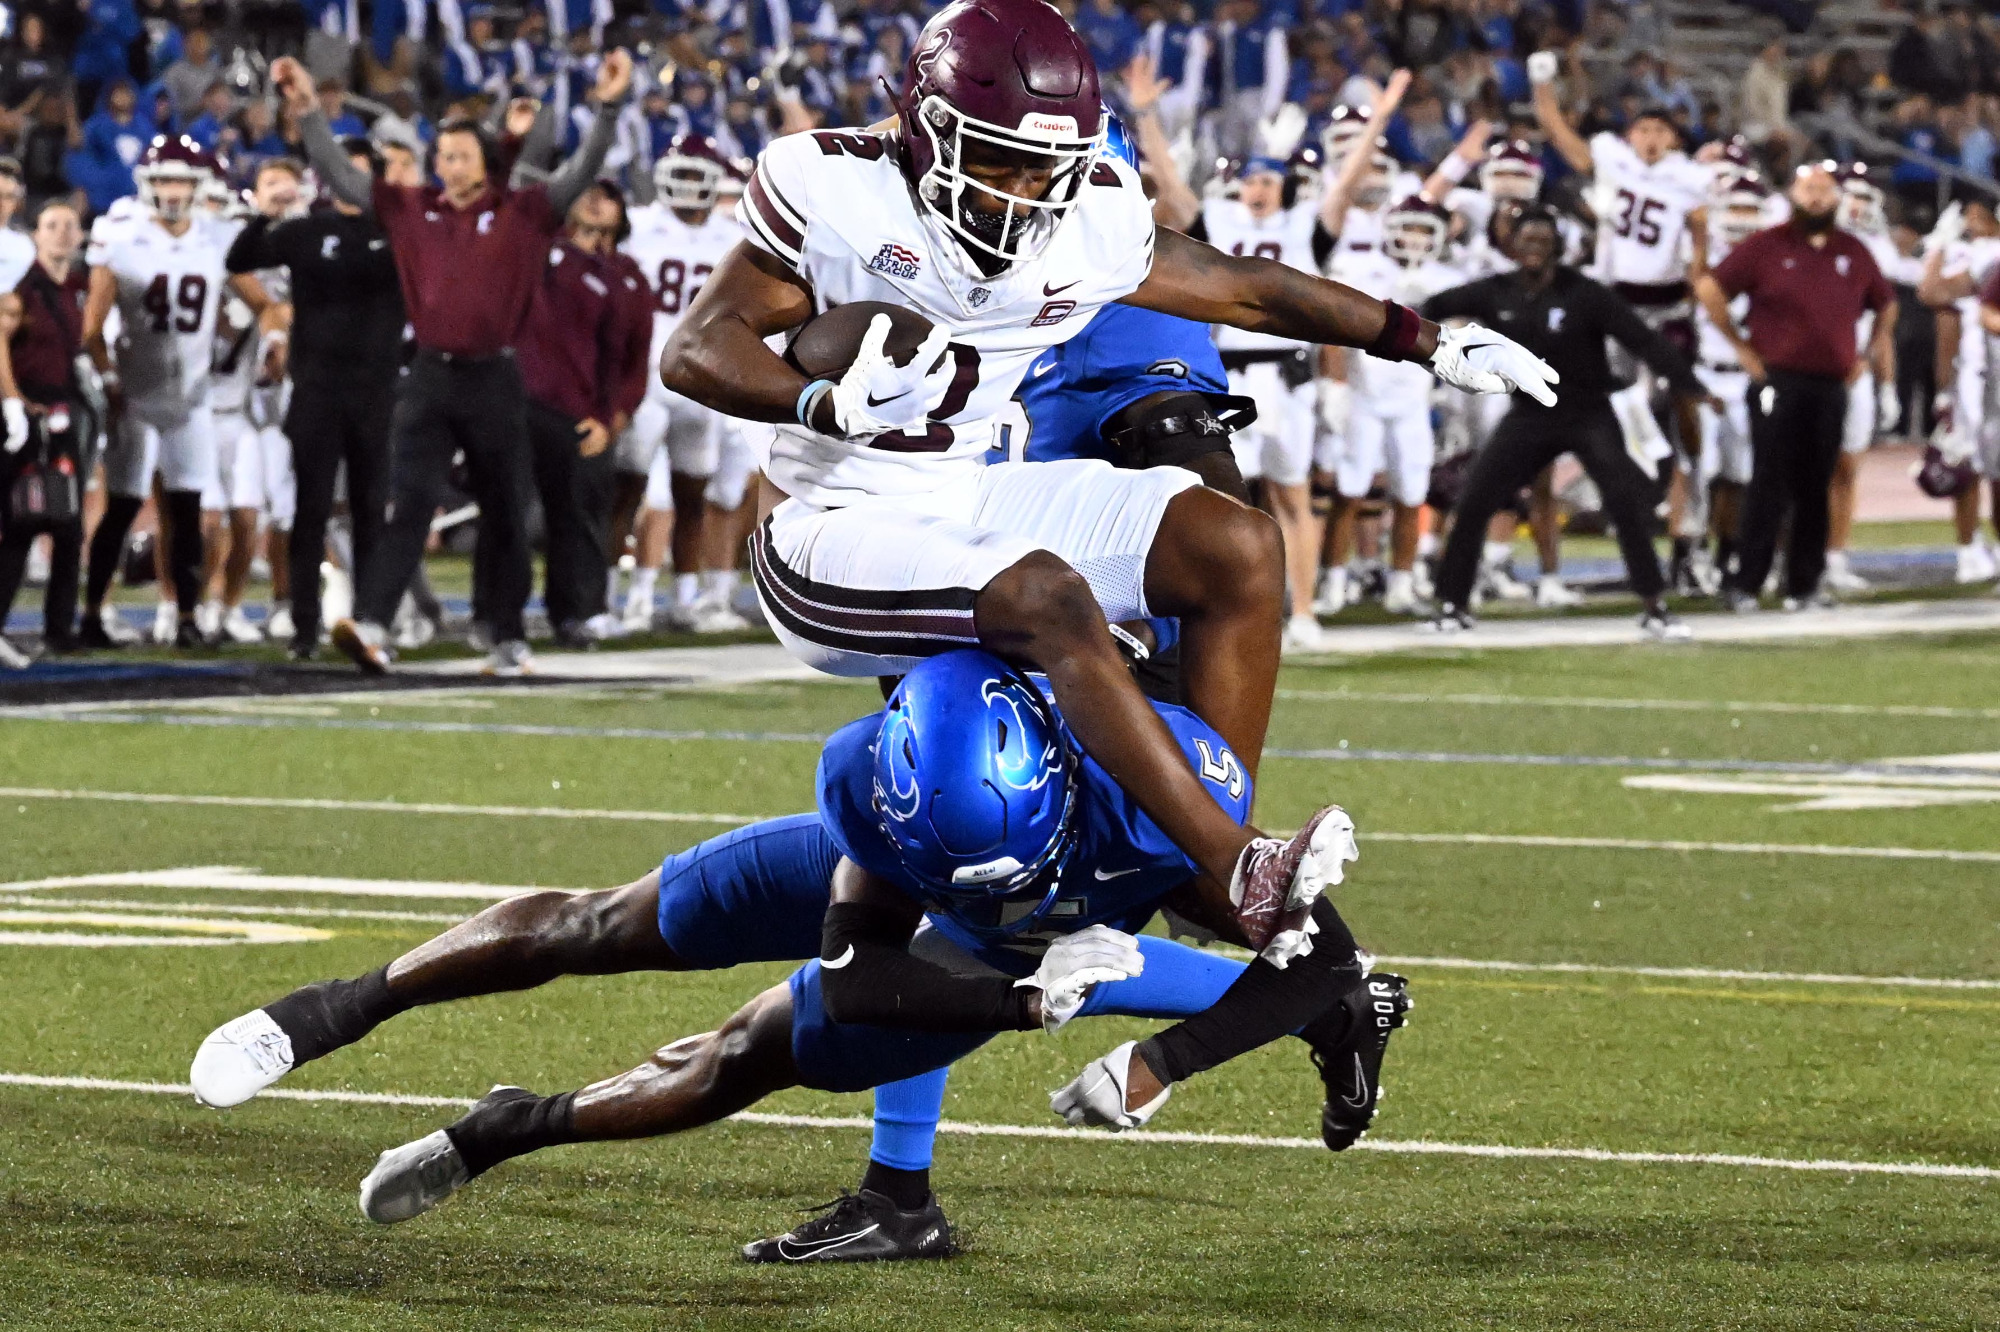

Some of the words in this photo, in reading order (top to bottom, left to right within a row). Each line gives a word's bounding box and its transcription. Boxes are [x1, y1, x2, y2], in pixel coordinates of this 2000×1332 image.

[811, 131, 886, 162] 2
[1615, 189, 1667, 247] 35
[868, 261, 916, 280] LEAGUE
[870, 255, 921, 276] PATRIOT
[142, 272, 207, 333] 49
[1192, 736, 1245, 803] 5
[1367, 981, 1395, 1050] POR
[917, 1228, 940, 1250] VAPOR
